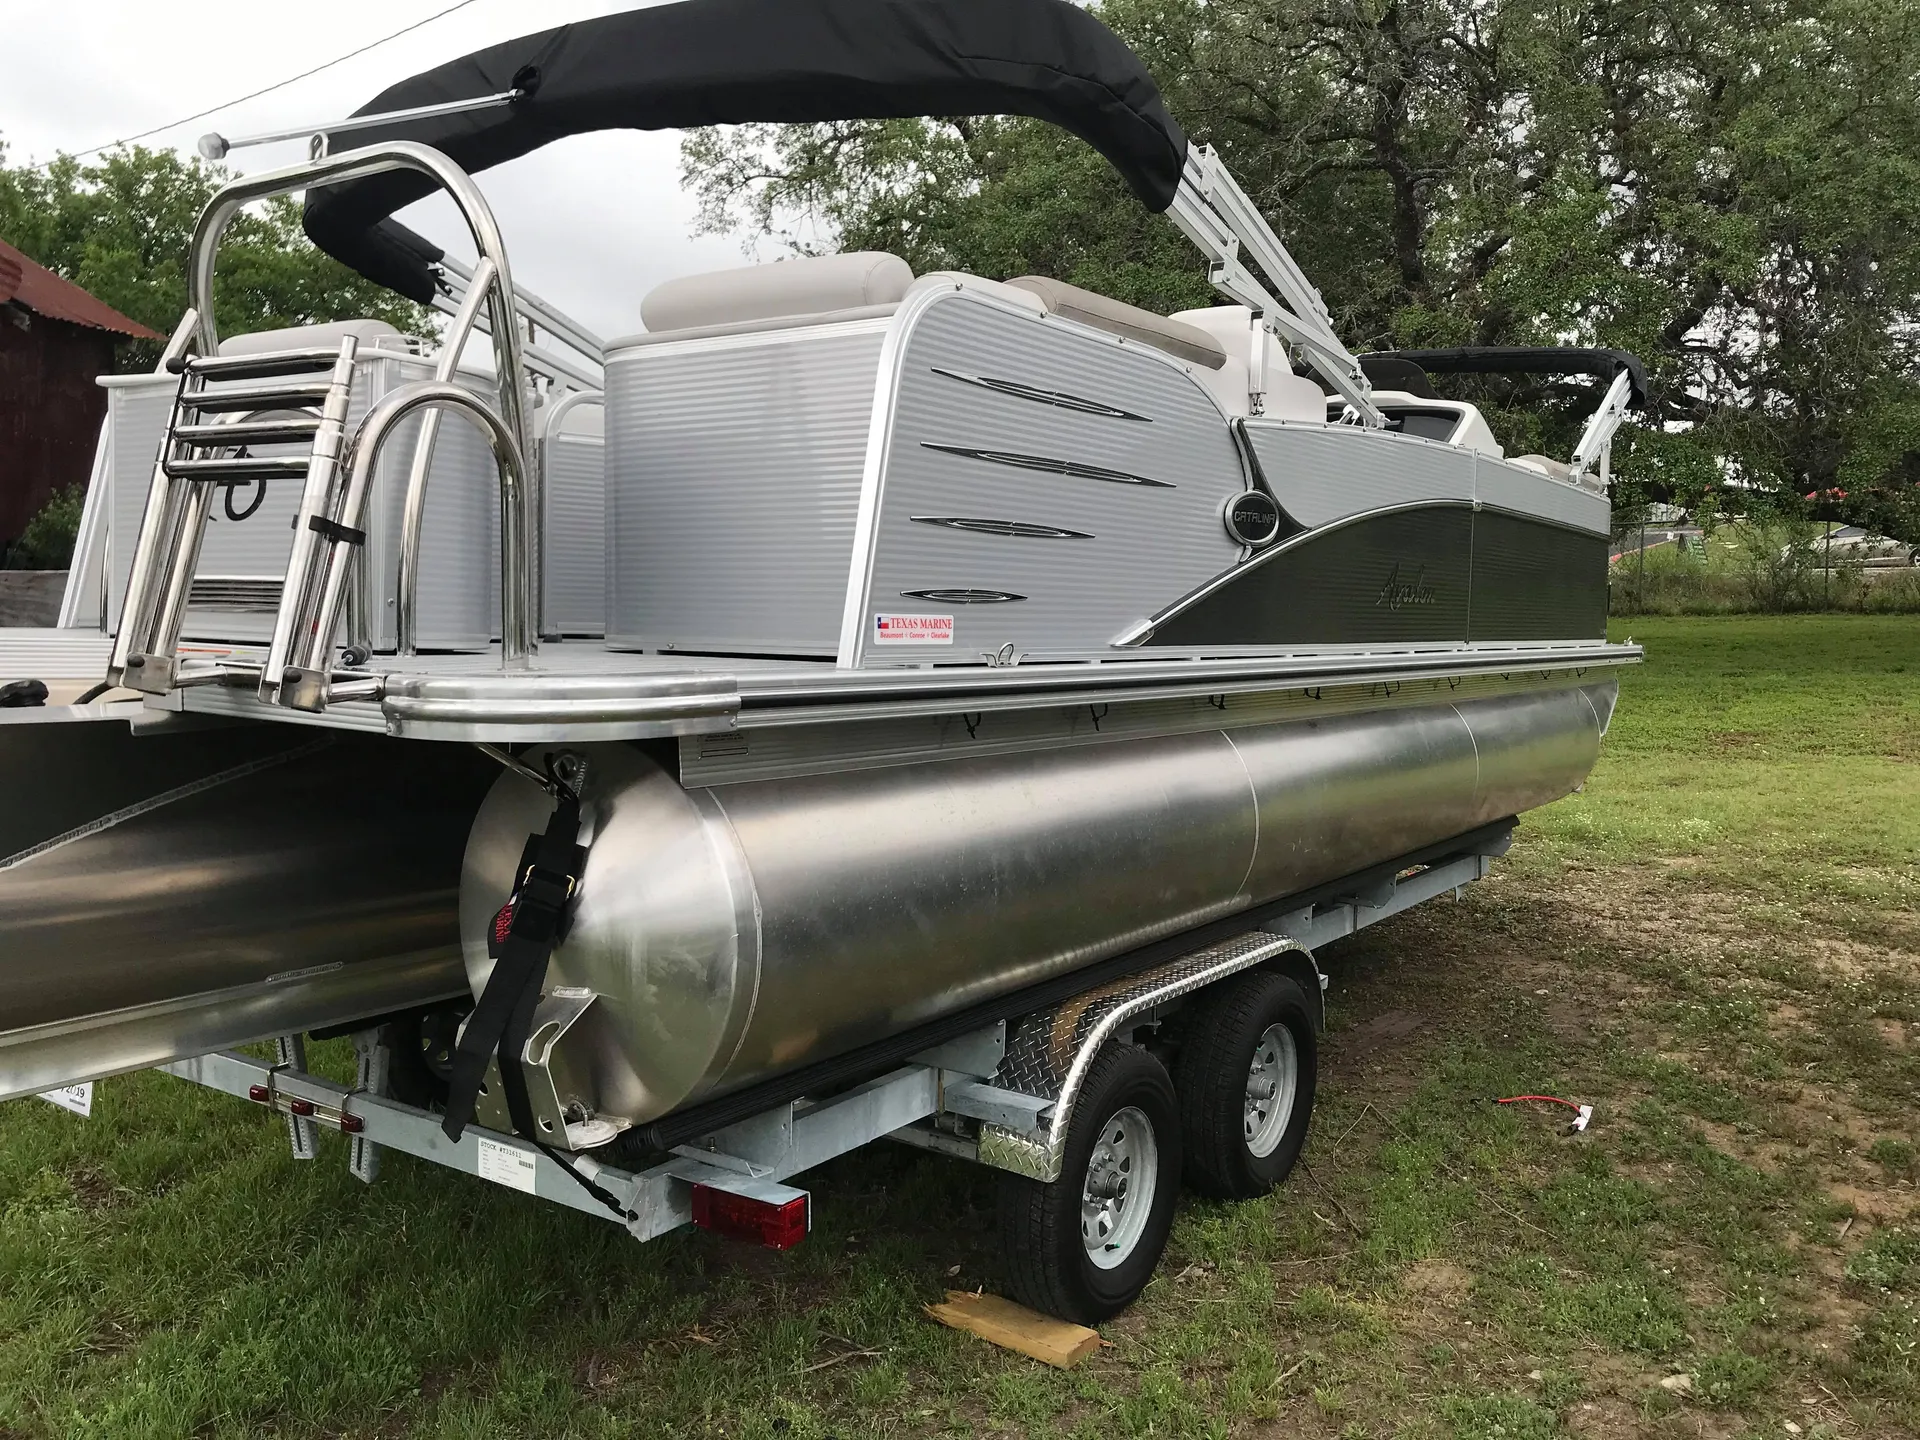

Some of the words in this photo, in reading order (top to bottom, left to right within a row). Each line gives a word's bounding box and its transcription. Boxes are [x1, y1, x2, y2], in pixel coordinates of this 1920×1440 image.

[1234, 510, 1275, 524] CATALINA
[890, 617, 918, 629] TEXAS
[920, 618, 952, 629] MARINE
[880, 631, 903, 639] Beaumont
[480, 1141, 497, 1151] STOCK
